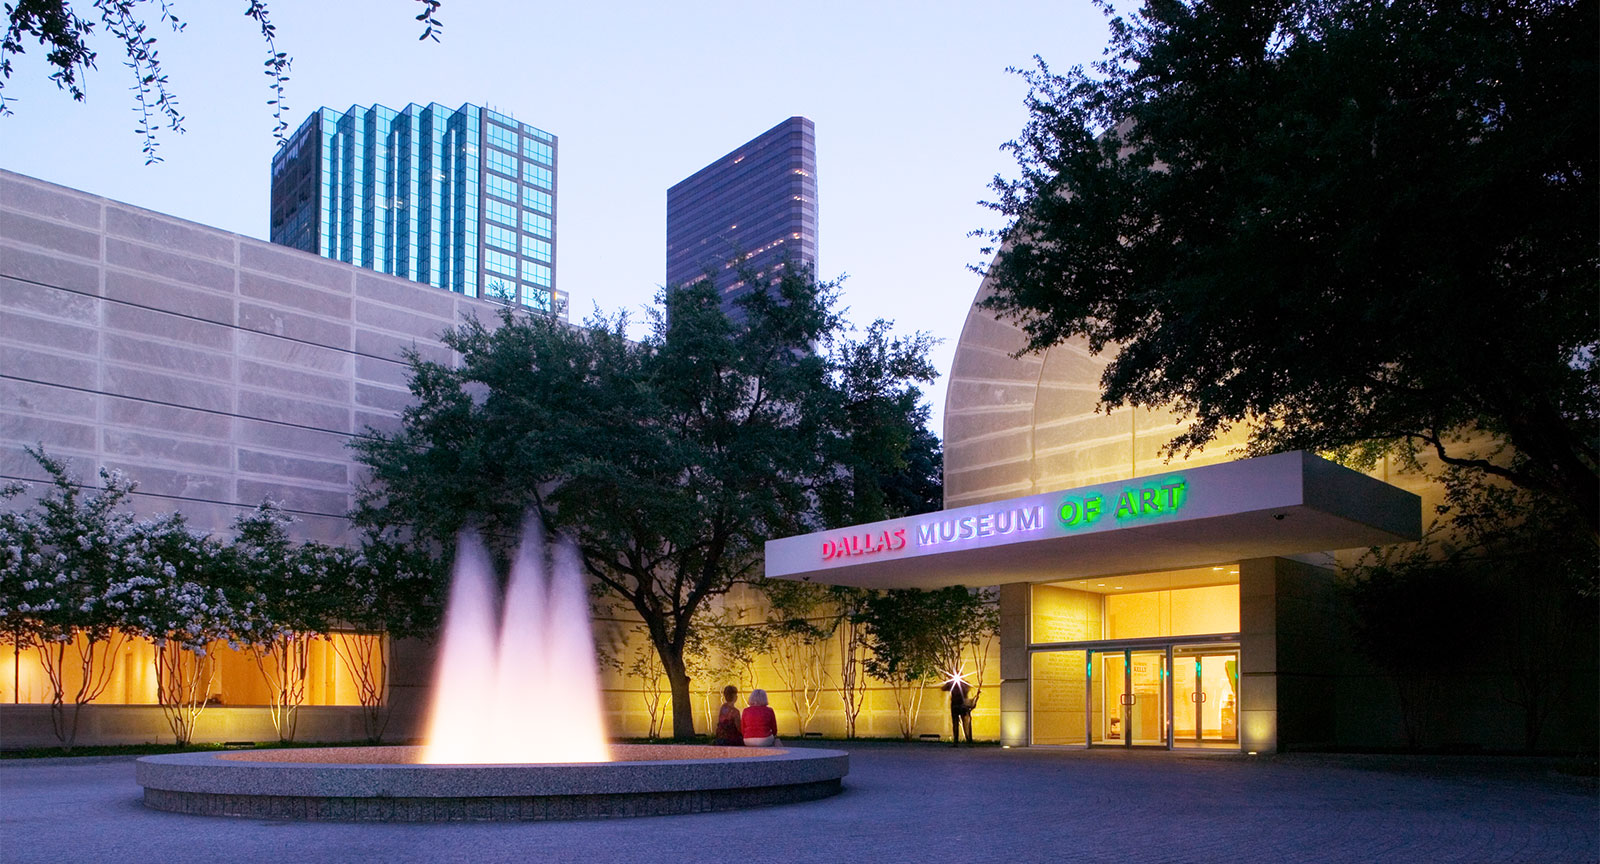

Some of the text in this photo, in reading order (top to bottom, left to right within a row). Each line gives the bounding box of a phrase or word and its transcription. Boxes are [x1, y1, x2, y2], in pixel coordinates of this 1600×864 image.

[821, 482, 1185, 560] DALLAS MUSEUM OF ART
